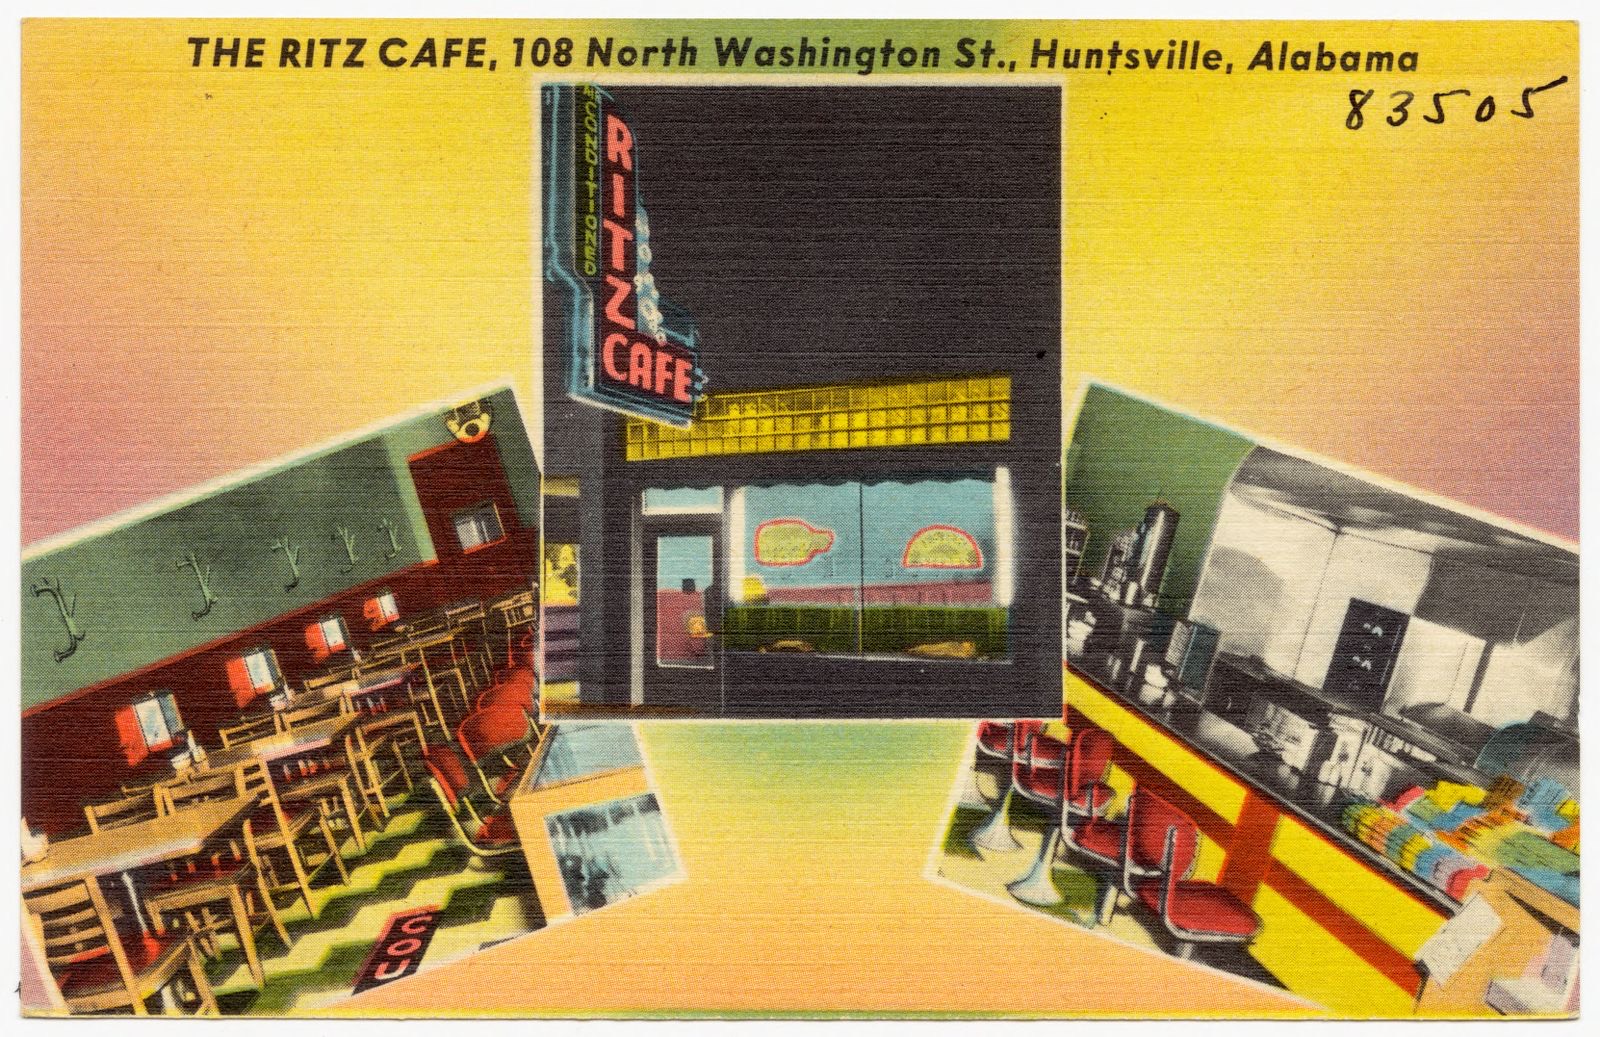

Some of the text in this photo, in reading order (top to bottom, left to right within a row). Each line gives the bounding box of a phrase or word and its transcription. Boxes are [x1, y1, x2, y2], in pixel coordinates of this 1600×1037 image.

[1345, 75, 1567, 129] 83505
[602, 113, 636, 331] RITZ
[602, 332, 693, 403] CAFE
